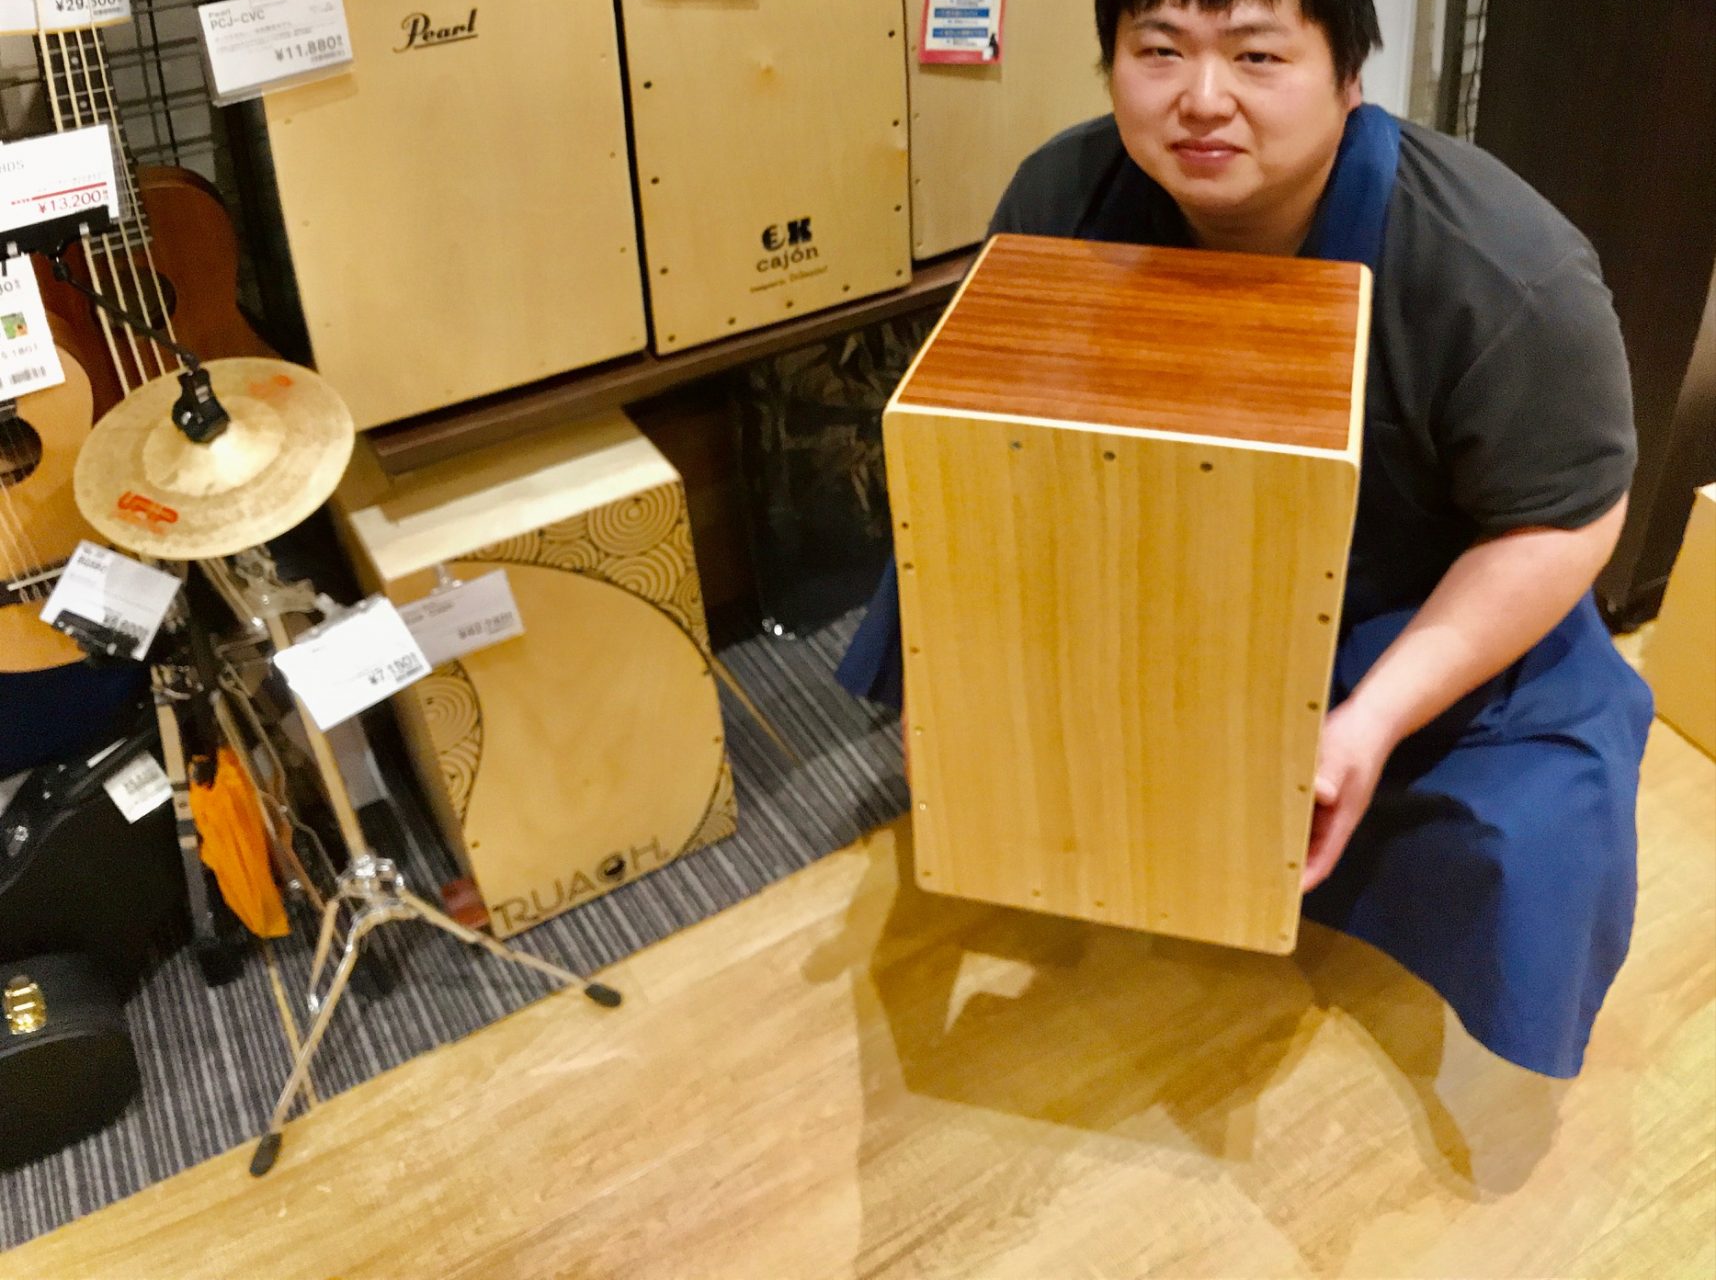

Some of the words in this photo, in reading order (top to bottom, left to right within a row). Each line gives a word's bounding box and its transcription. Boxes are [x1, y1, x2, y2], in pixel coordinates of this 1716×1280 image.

[210, 10, 266, 31] PCJ-CVC
[392, 8, 479, 54] Pearl
[274, 35, 337, 61] ¥11,880
[38, 190, 102, 214] ¥13,200
